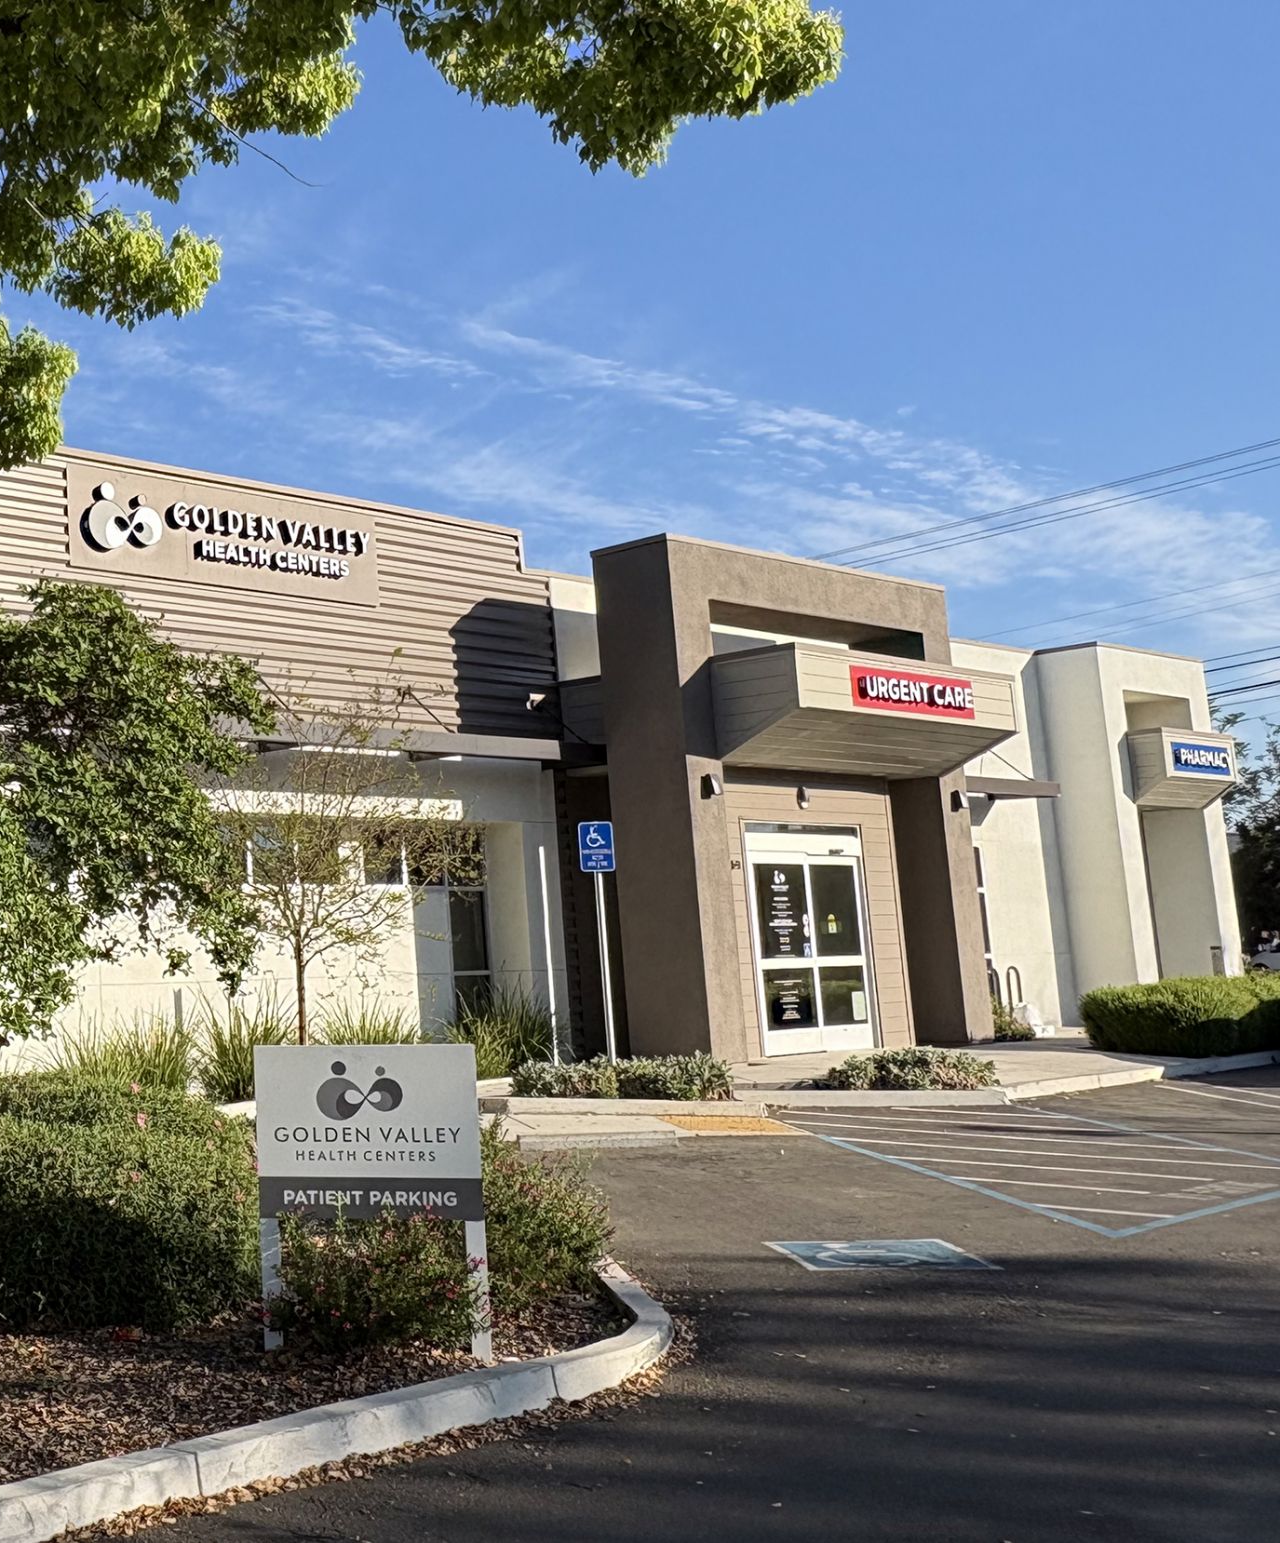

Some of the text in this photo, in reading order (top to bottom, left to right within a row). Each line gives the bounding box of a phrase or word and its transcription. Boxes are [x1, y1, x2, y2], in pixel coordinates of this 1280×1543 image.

[172, 501, 371, 554] GOLDEN VALLEY
[201, 539, 351, 578] HEALTH CENTERS
[866, 675, 975, 709] URGENT CARE
[273, 1126, 462, 1144] GOLDEN VALLEY
[295, 1149, 437, 1163] HEALTH CENTERS
[283, 1189, 458, 1207] PATIENT PARKING
